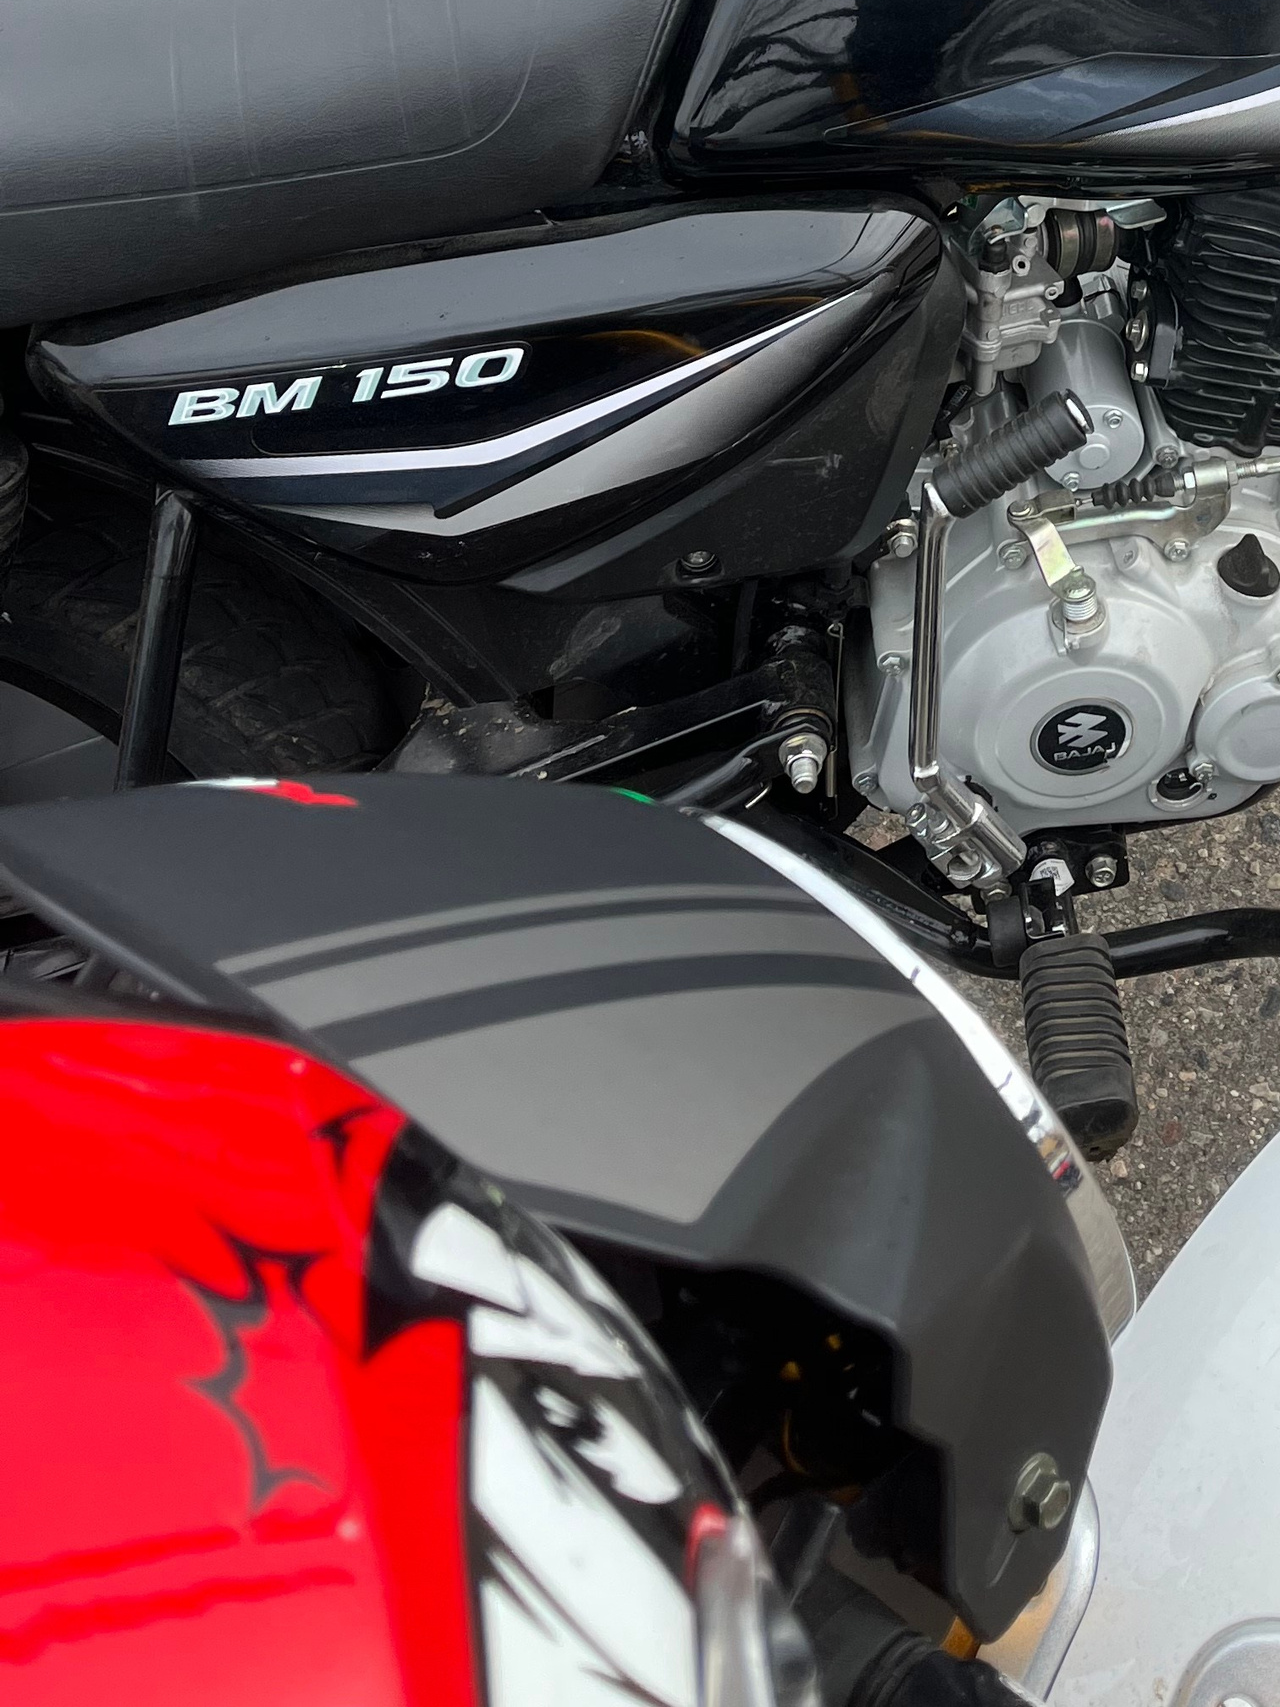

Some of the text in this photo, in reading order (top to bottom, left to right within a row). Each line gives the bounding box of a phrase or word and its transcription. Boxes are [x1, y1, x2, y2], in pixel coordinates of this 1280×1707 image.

[168, 347, 524, 426] BM 150
[1054, 742, 1116, 761] BAJAJ
